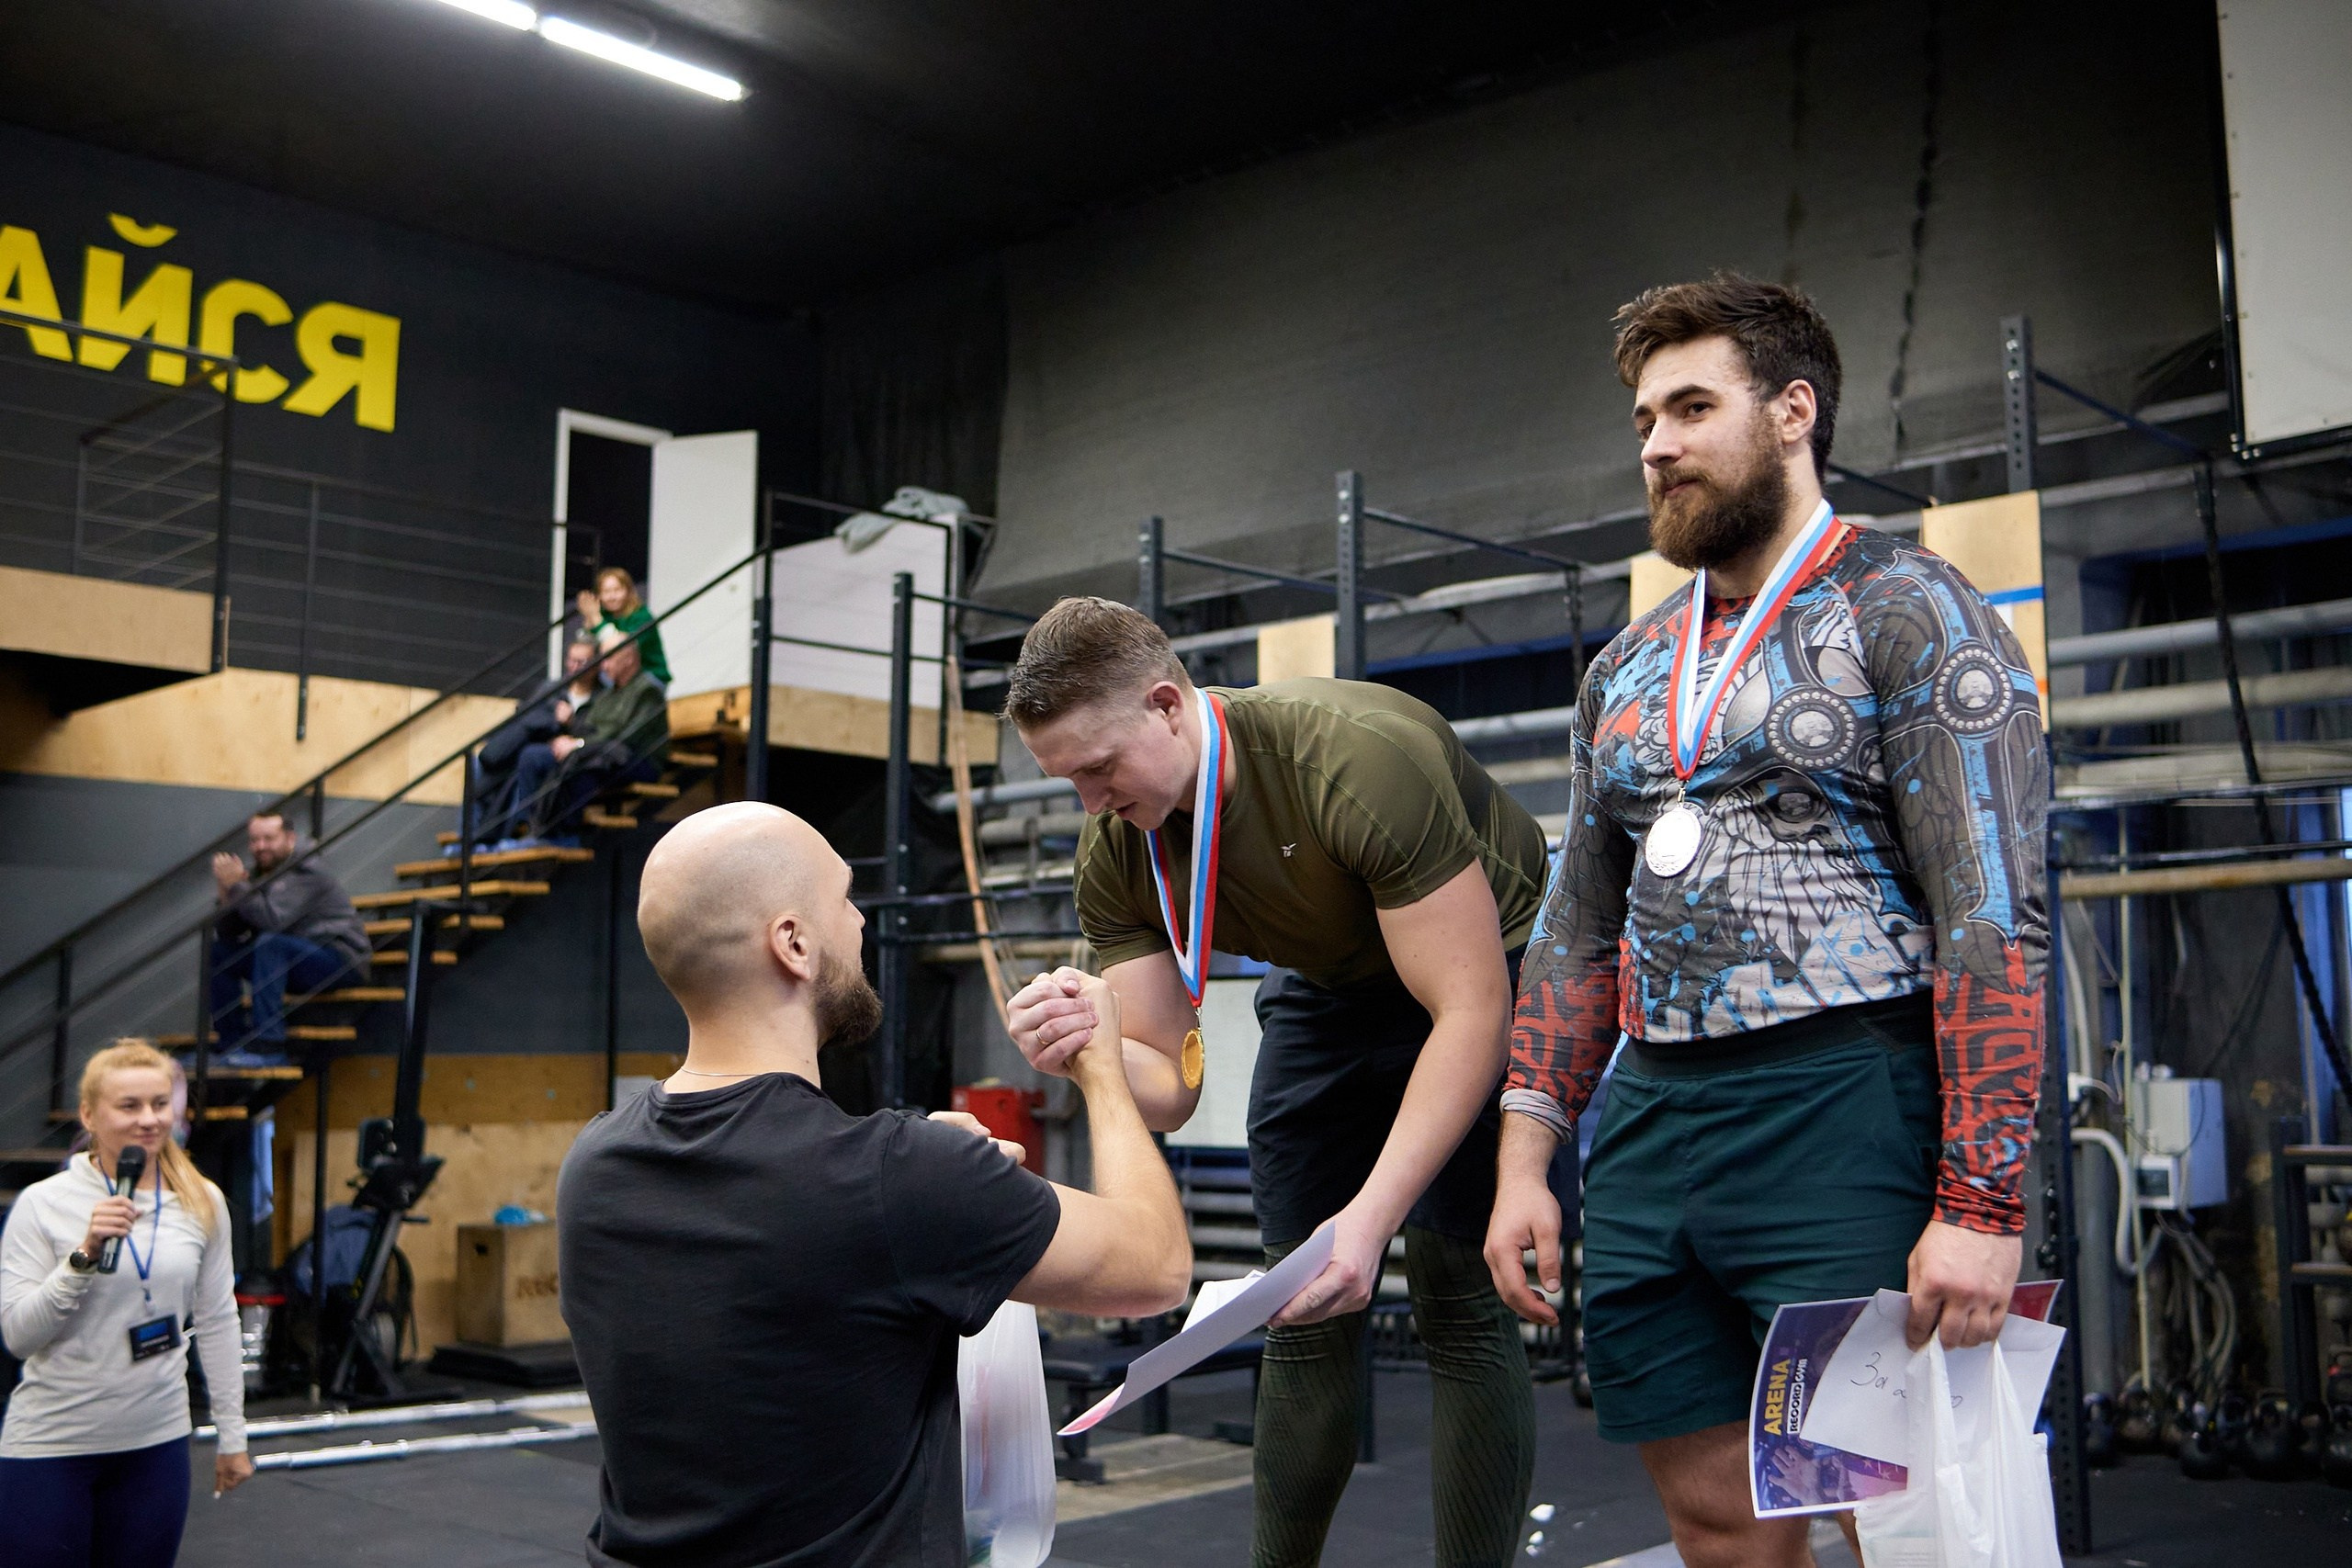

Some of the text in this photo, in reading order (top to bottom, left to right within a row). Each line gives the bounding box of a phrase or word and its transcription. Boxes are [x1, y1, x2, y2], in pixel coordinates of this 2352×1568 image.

[0, 212, 401, 433] АЙСЯ
[1764, 1359, 1791, 1436] ARENA
[1789, 1383, 1803, 1432] RECORD
